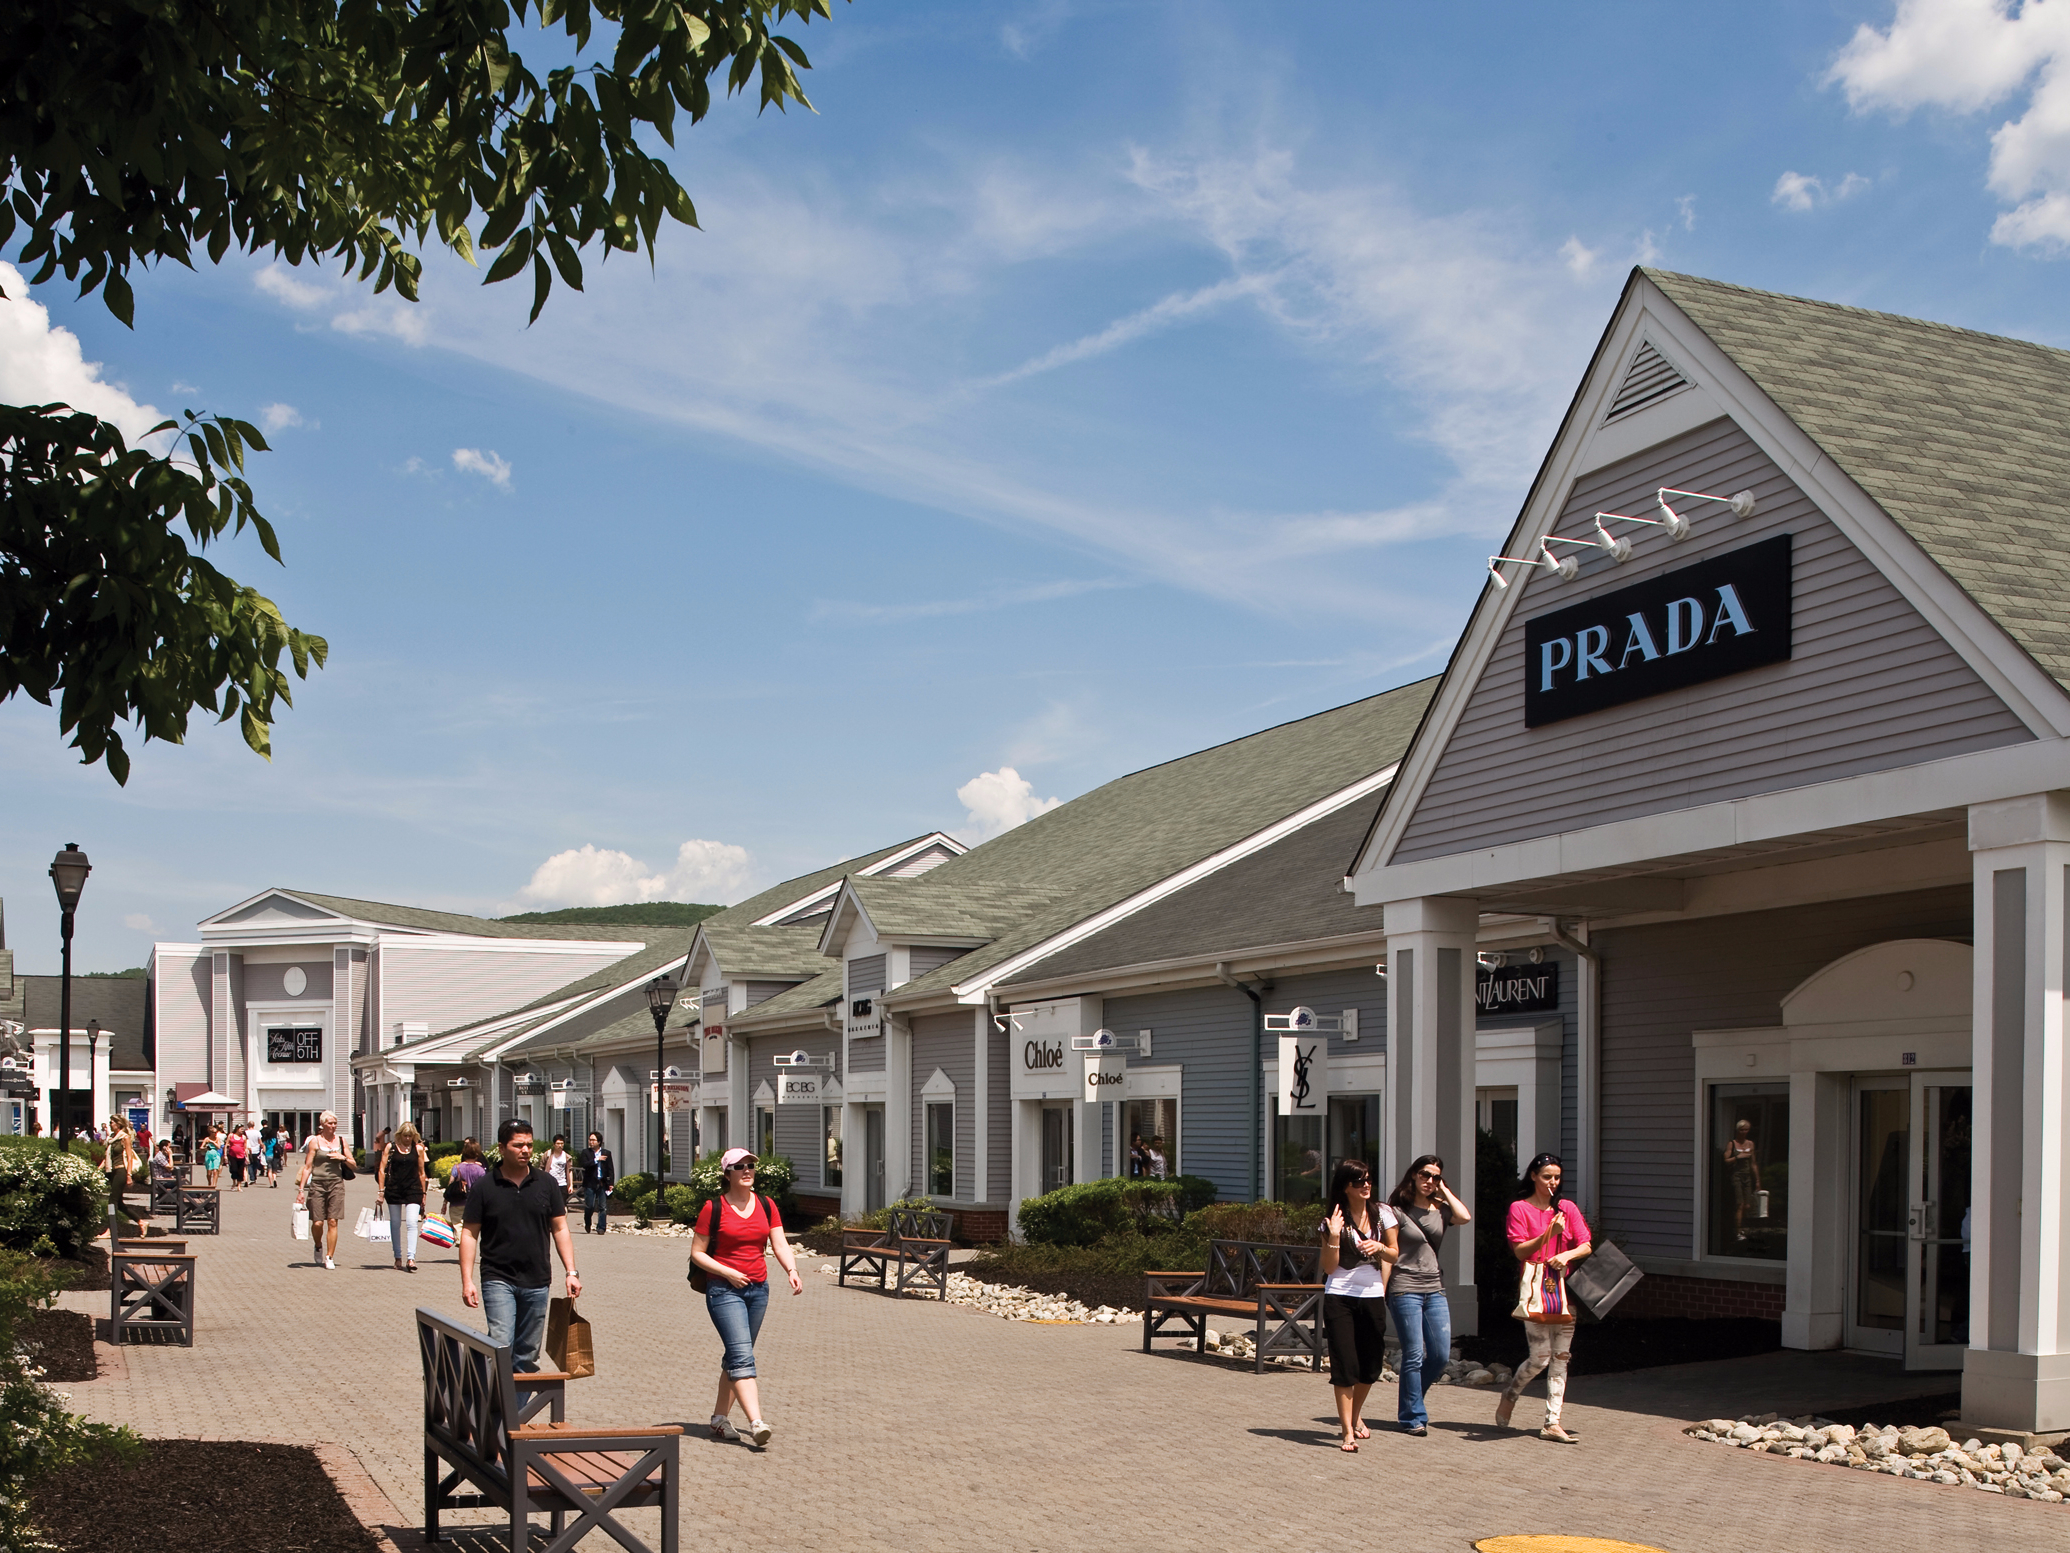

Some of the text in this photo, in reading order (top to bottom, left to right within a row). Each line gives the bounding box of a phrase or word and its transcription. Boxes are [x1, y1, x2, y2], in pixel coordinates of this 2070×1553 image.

[1539, 583, 1758, 693] PRADA
[296, 1032, 318, 1046] OFF
[297, 1045, 319, 1059] 5TH
[1024, 1040, 1063, 1070] Chloé
[1088, 1072, 1123, 1087] Chloé
[1290, 1045, 1317, 1109] YSL
[786, 1082, 815, 1093] BCBG
